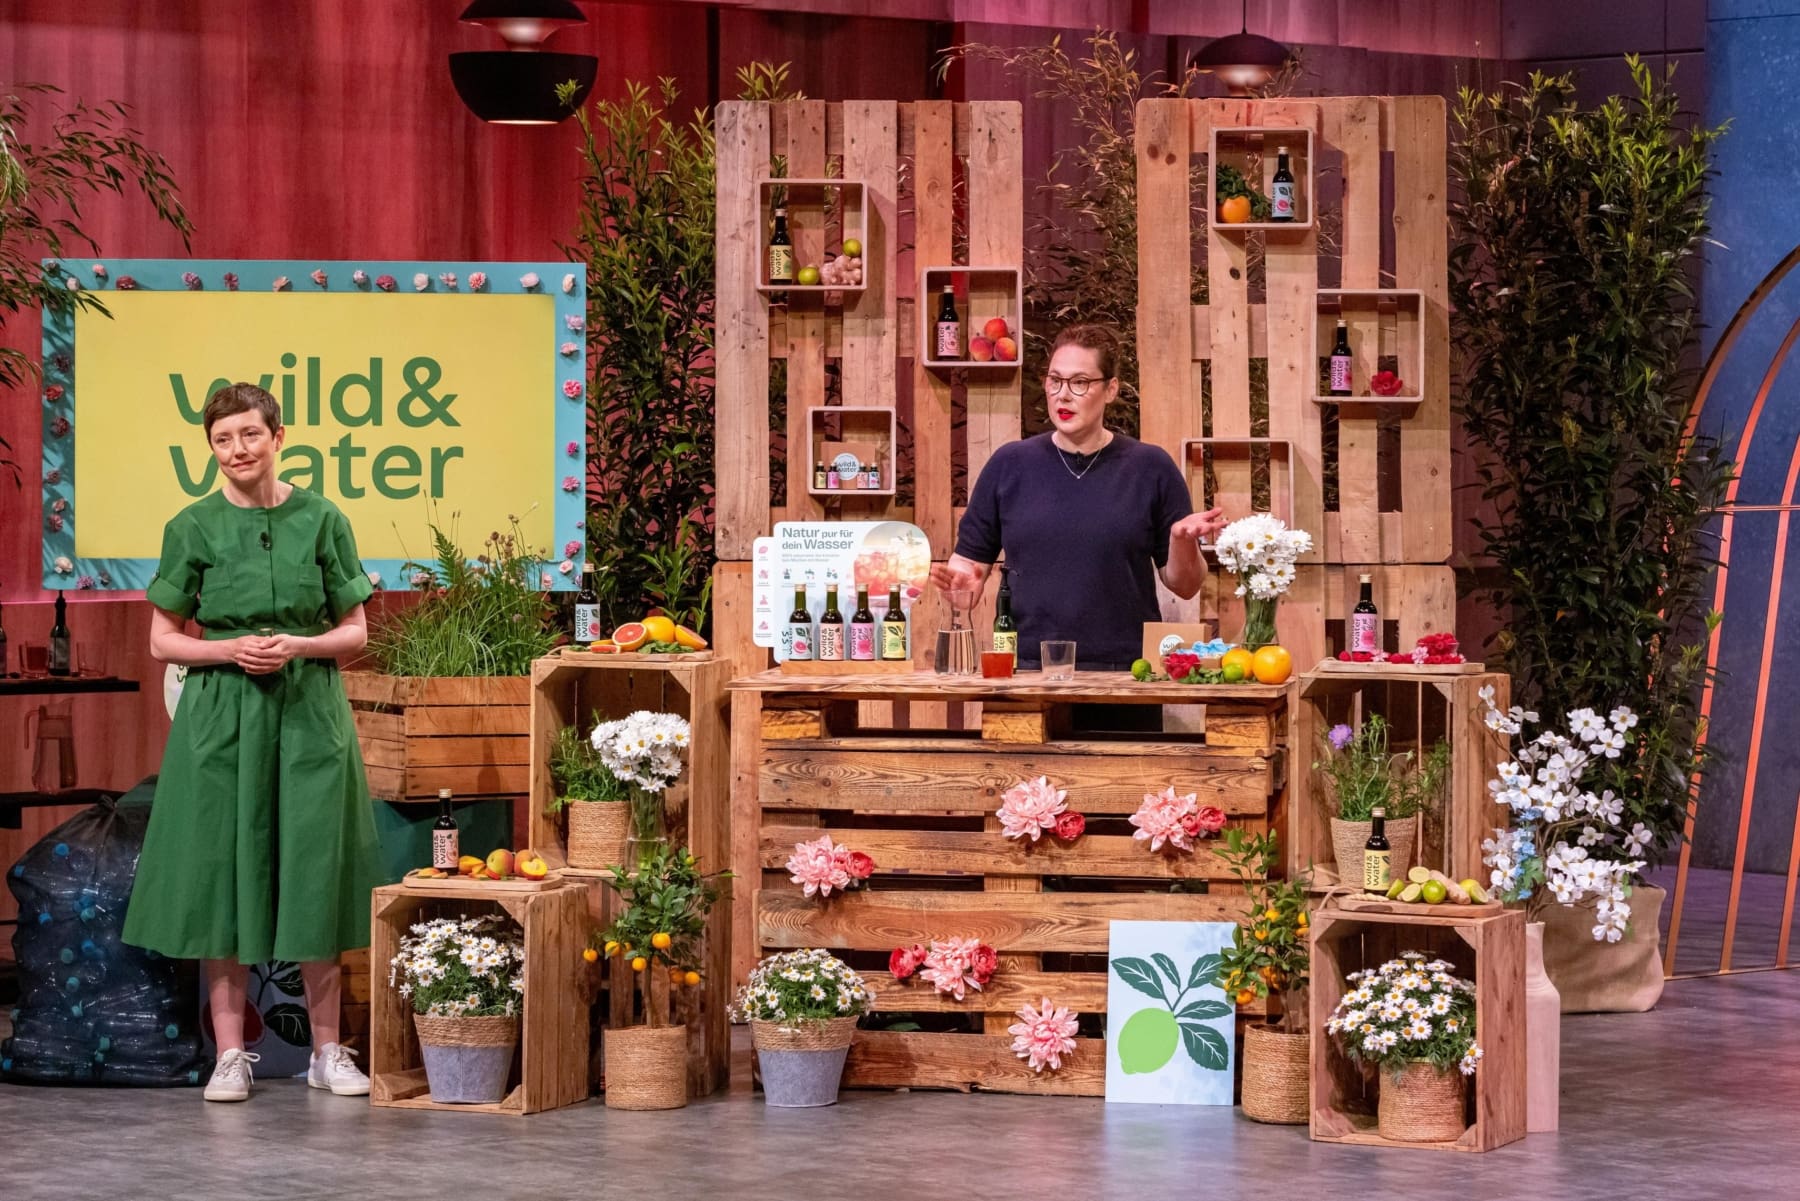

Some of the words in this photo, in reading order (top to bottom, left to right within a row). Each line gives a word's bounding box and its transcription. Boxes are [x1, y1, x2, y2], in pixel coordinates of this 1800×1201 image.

[782, 527, 820, 538] Natur
[822, 531, 838, 539] pur
[839, 529, 854, 538] für
[782, 540, 802, 549] dein
[803, 539, 854, 550] Wasser
